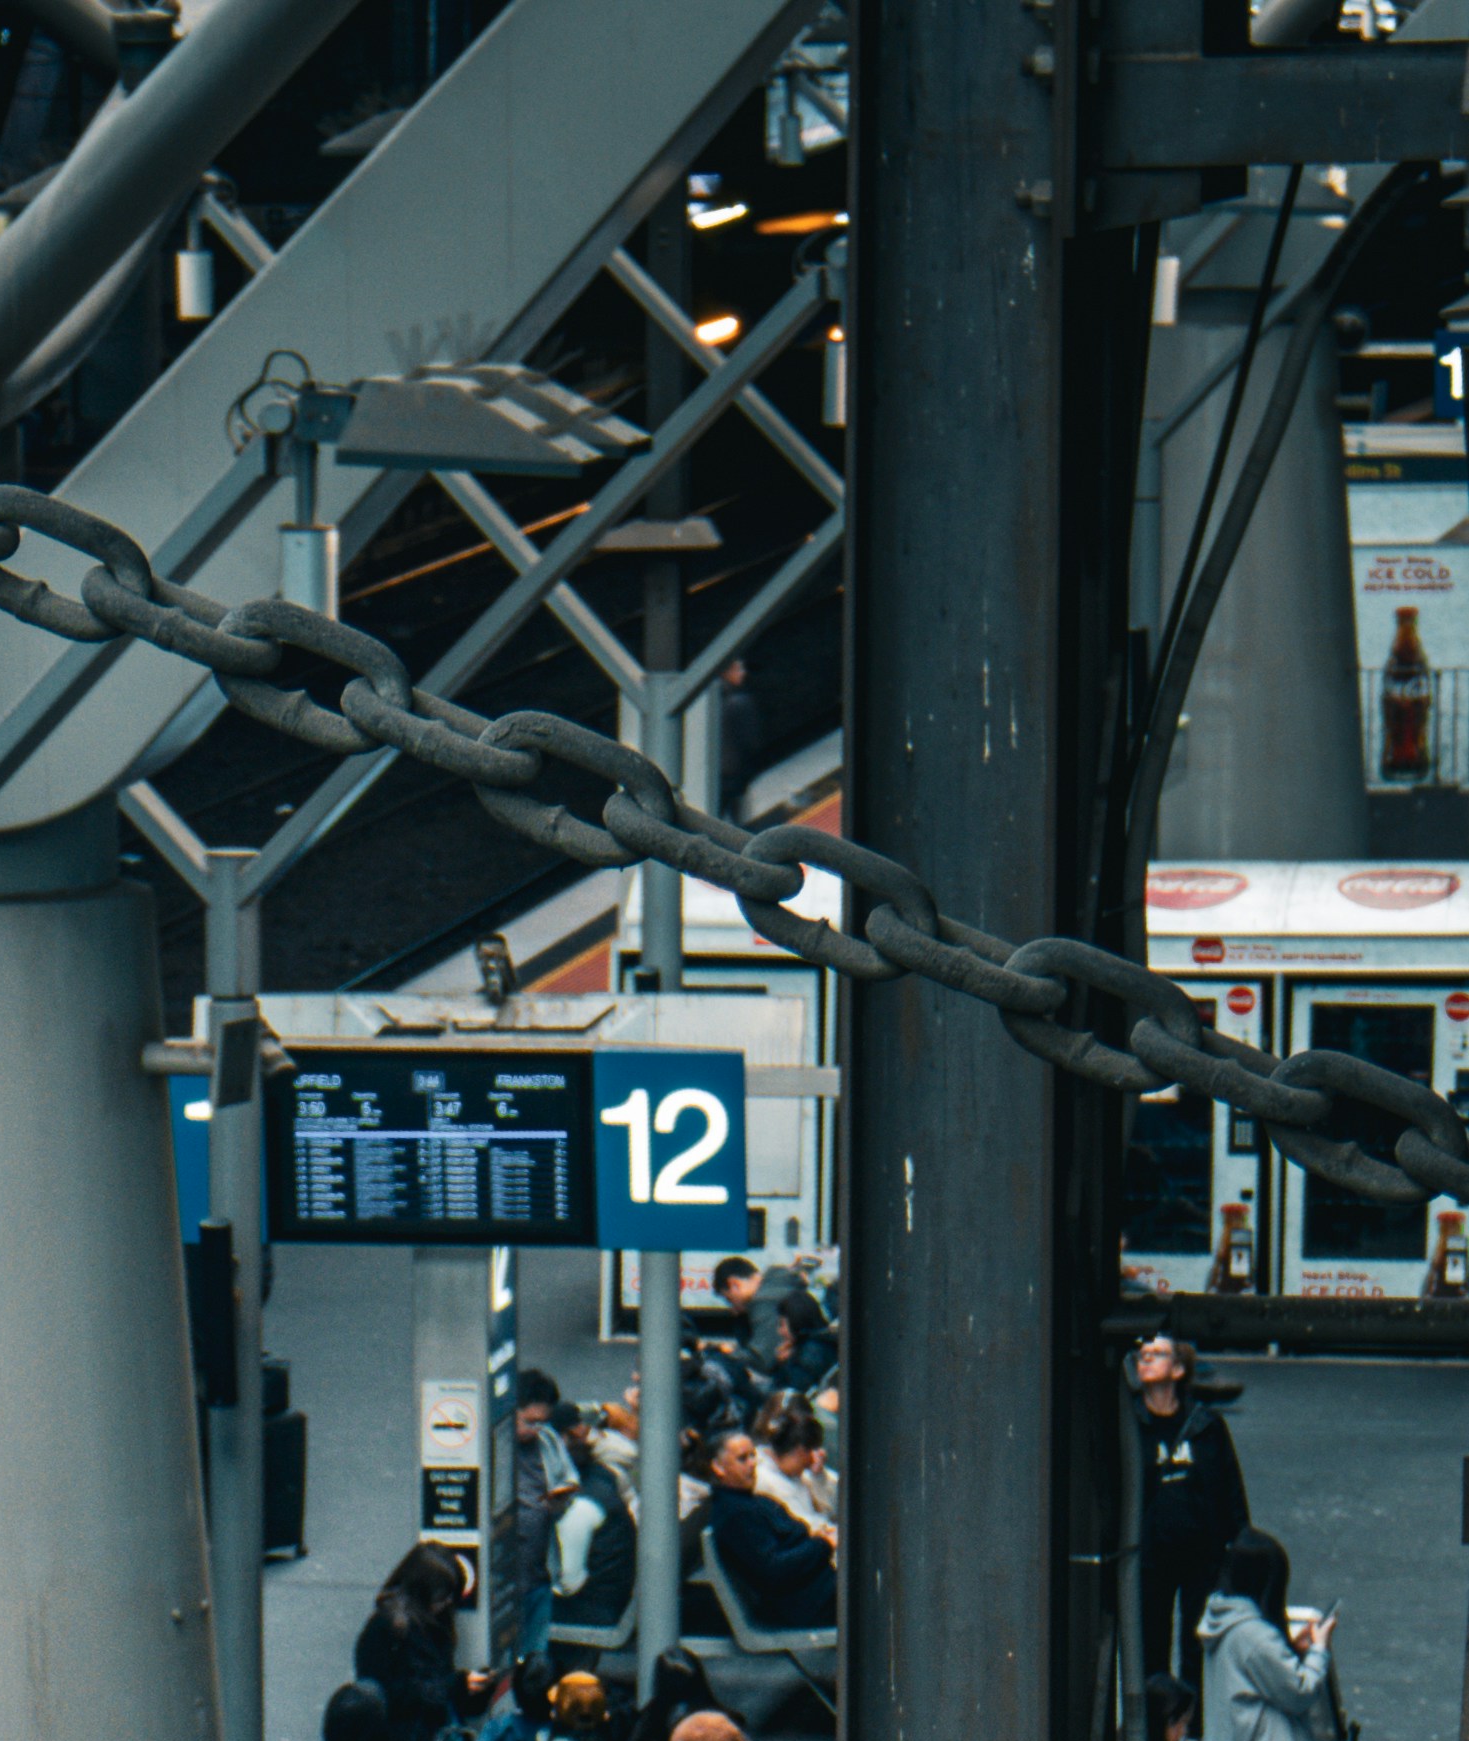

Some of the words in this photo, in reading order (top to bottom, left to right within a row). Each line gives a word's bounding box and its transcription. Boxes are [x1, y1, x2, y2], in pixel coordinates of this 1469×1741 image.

[1368, 567, 1396, 579] ICE
[1402, 566, 1451, 579] COLD
[495, 1073, 566, 1090] FRANKSTON
[601, 1088, 729, 1204] 12
